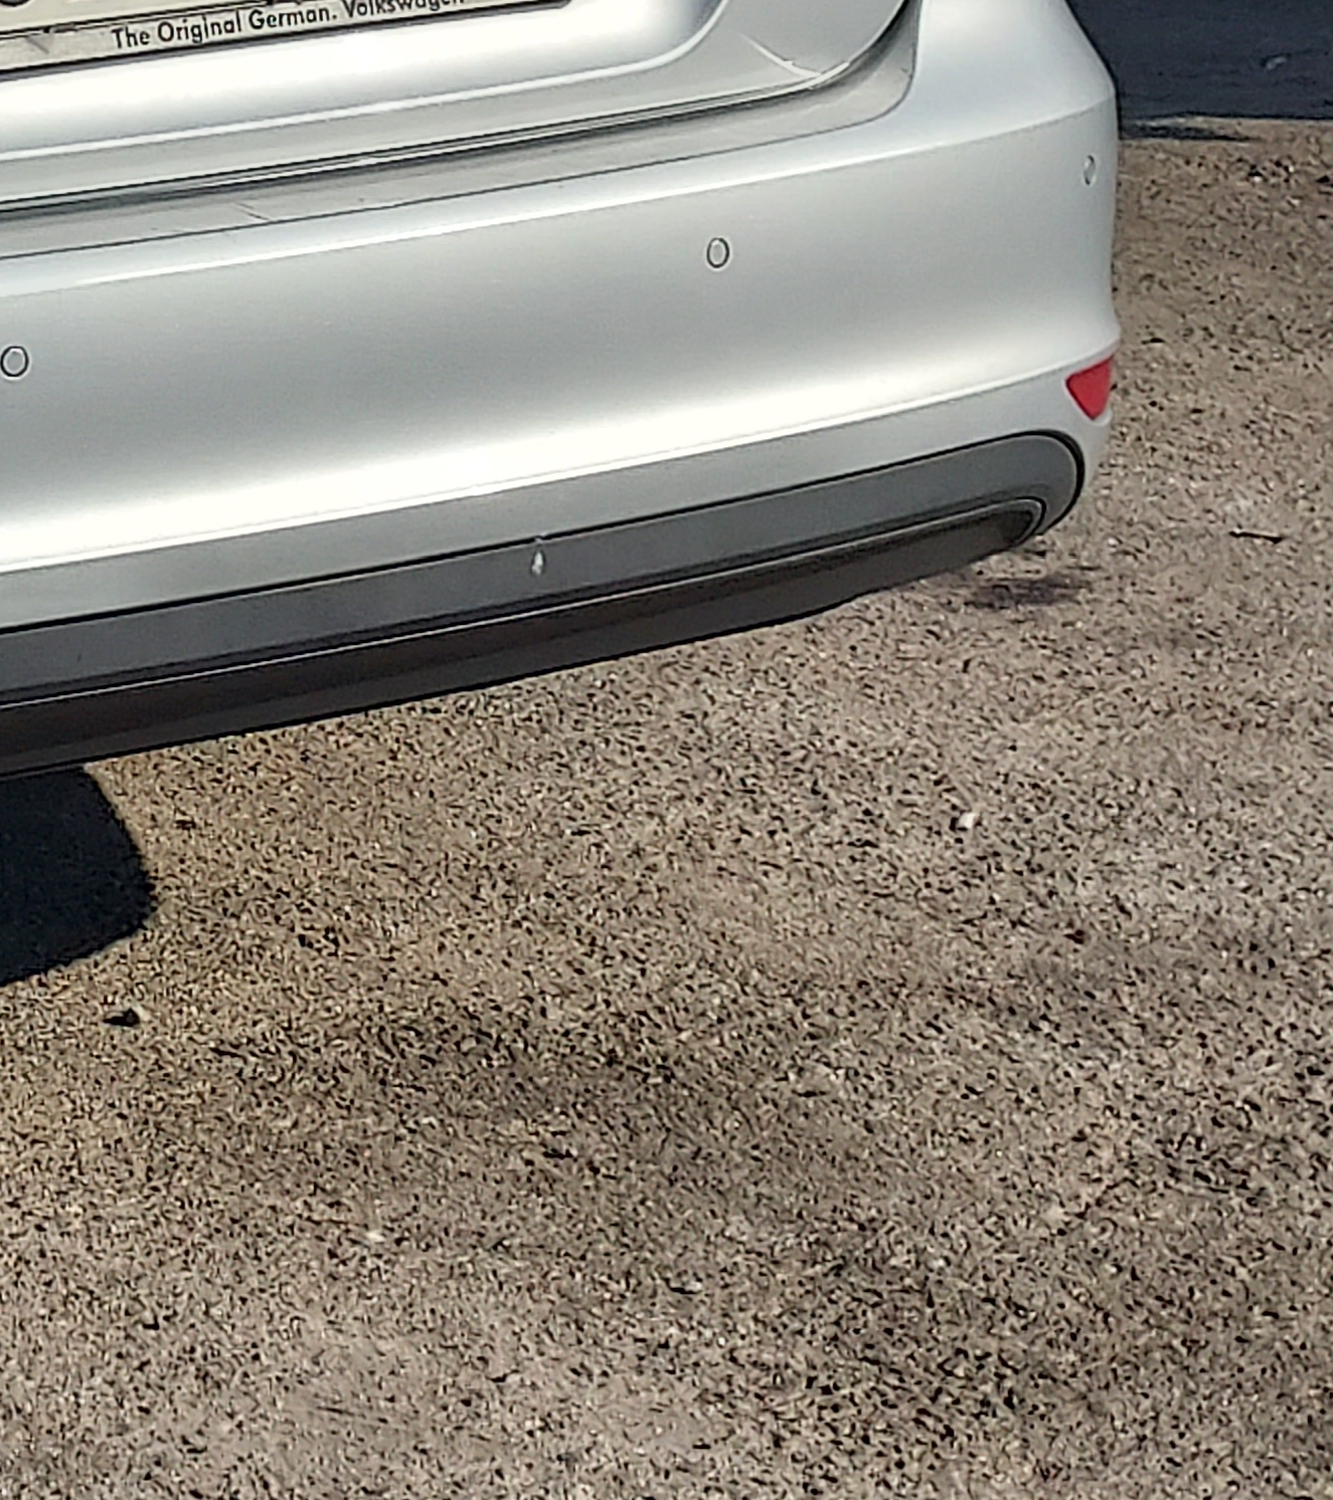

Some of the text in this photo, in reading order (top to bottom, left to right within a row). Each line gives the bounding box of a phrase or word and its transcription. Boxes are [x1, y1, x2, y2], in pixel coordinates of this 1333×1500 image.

[111, 25, 151, 50] The
[156, 11, 243, 44] Original
[248, 6, 338, 31] German.
